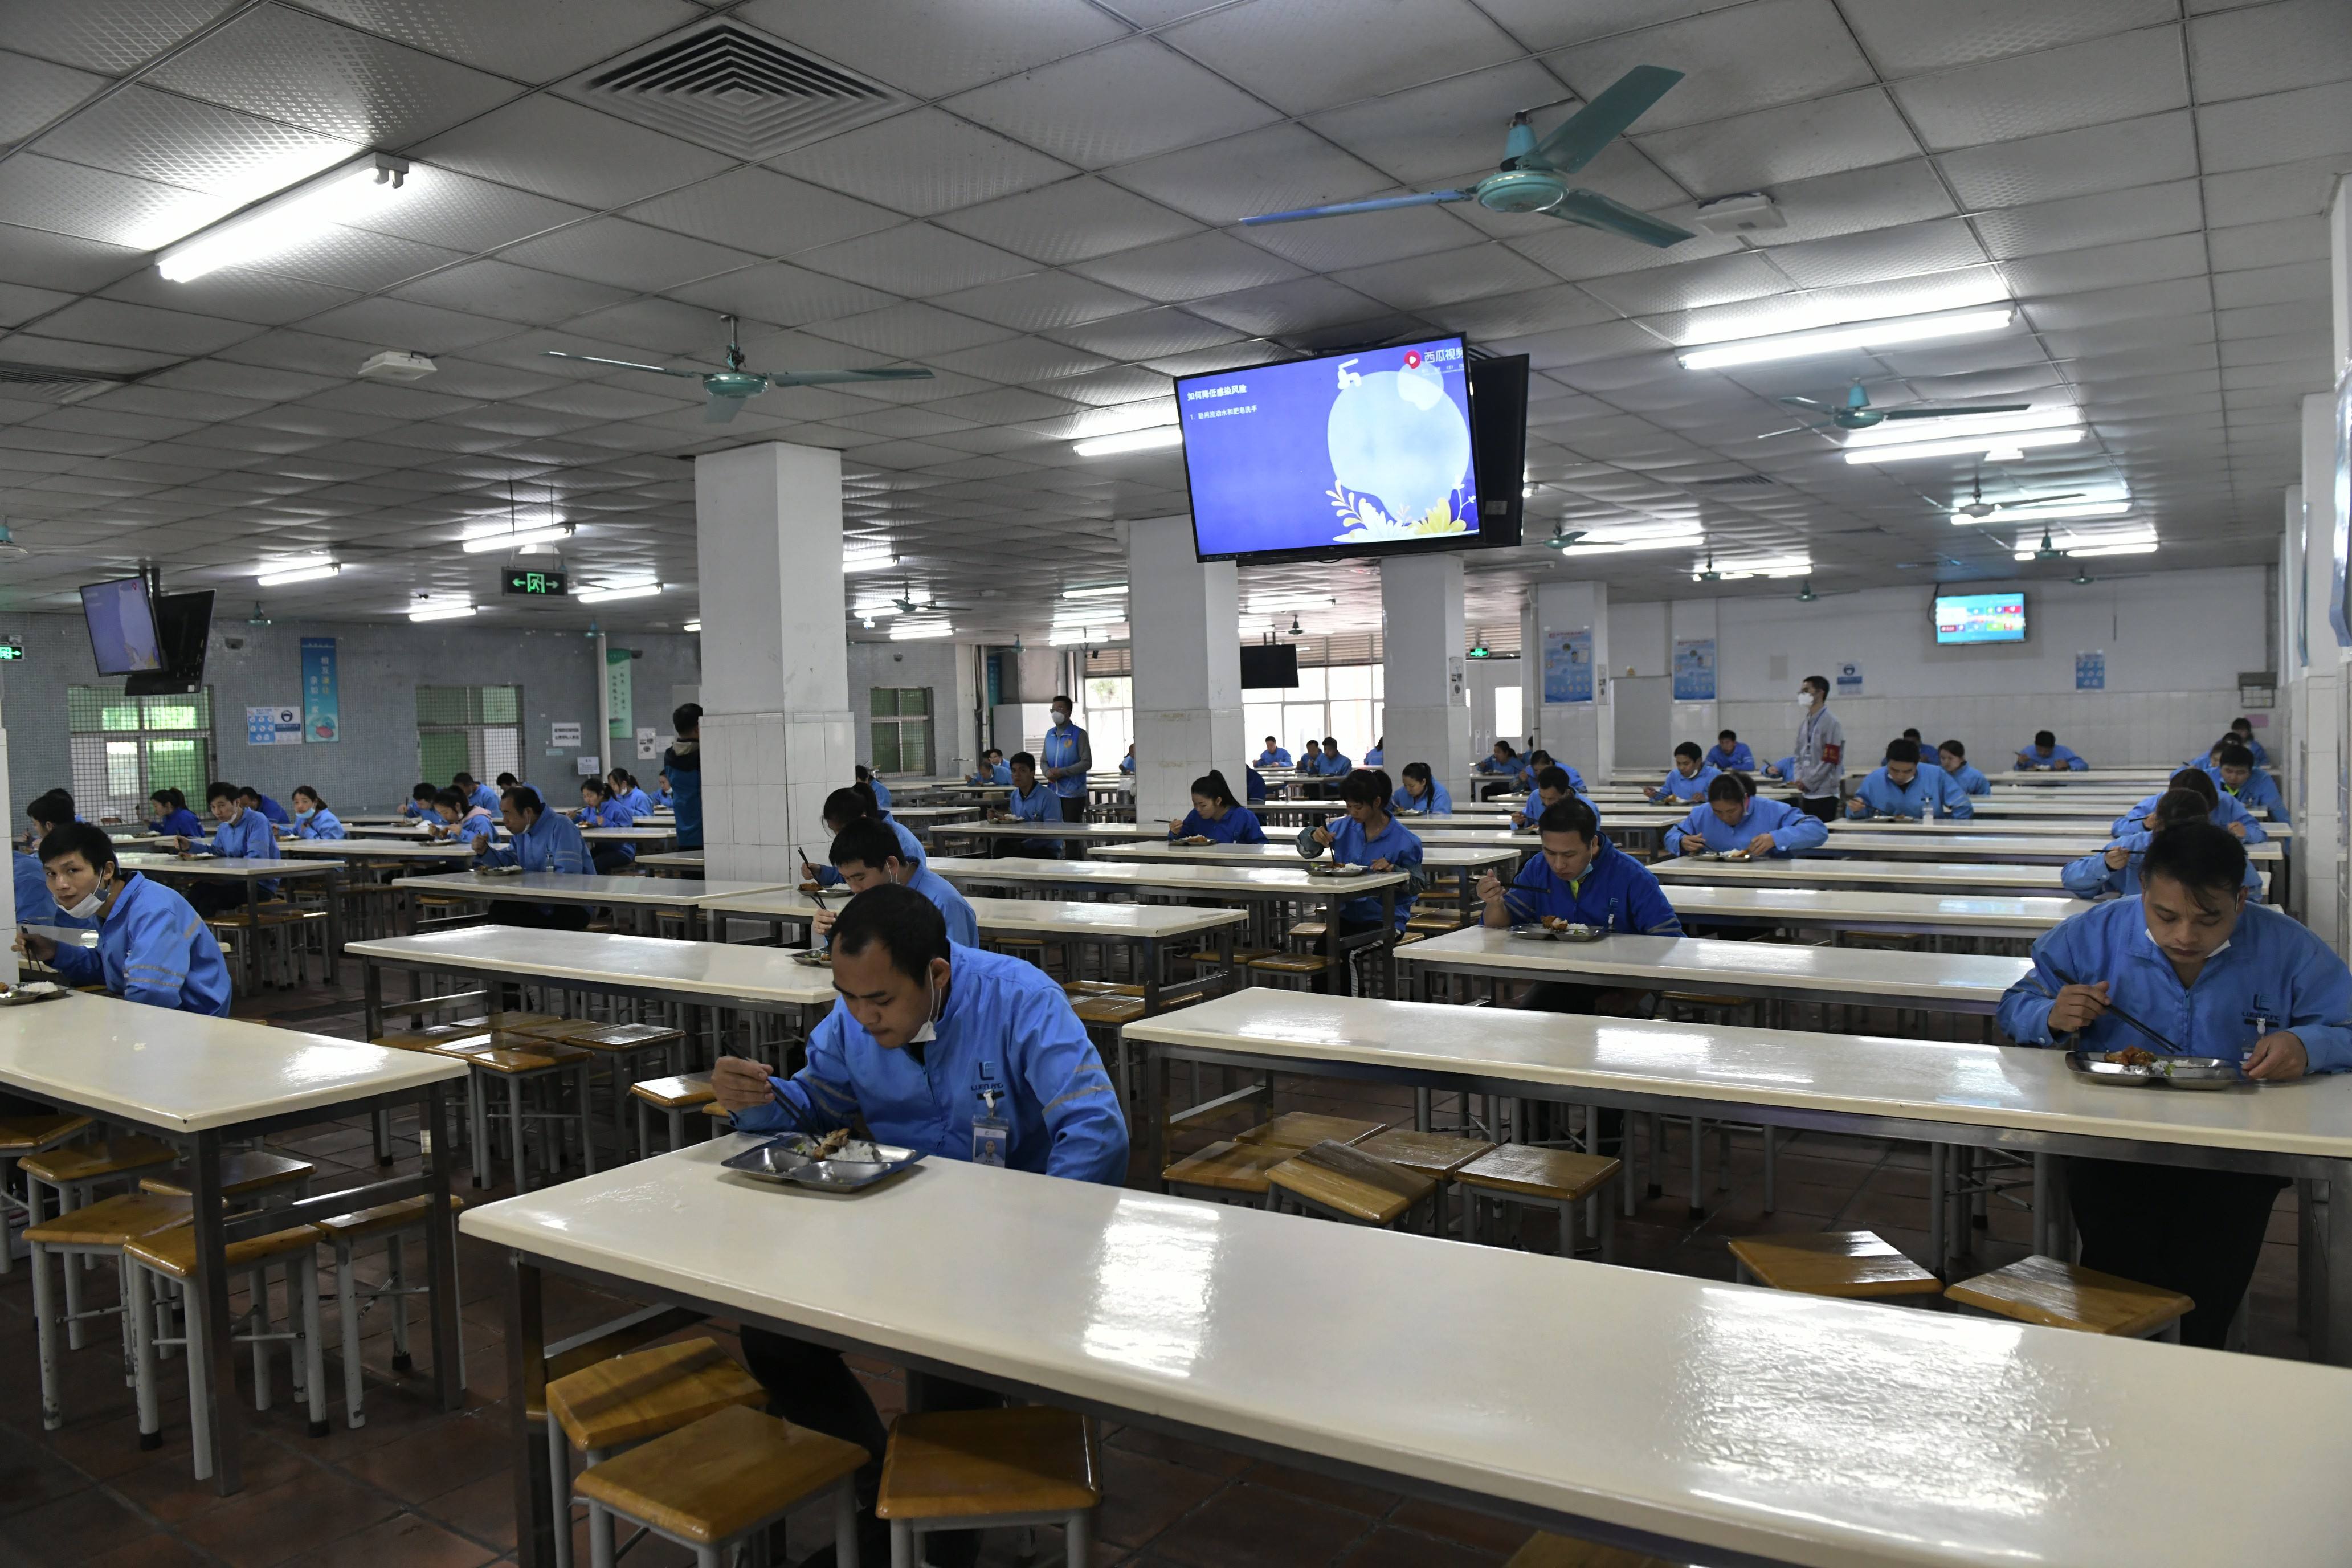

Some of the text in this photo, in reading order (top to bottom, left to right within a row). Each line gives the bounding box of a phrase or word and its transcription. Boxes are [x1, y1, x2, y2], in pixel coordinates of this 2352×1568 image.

[1423, 346, 1464, 364] 西瓜视频
[1187, 384, 1247, 401] 如何降低感染风险
